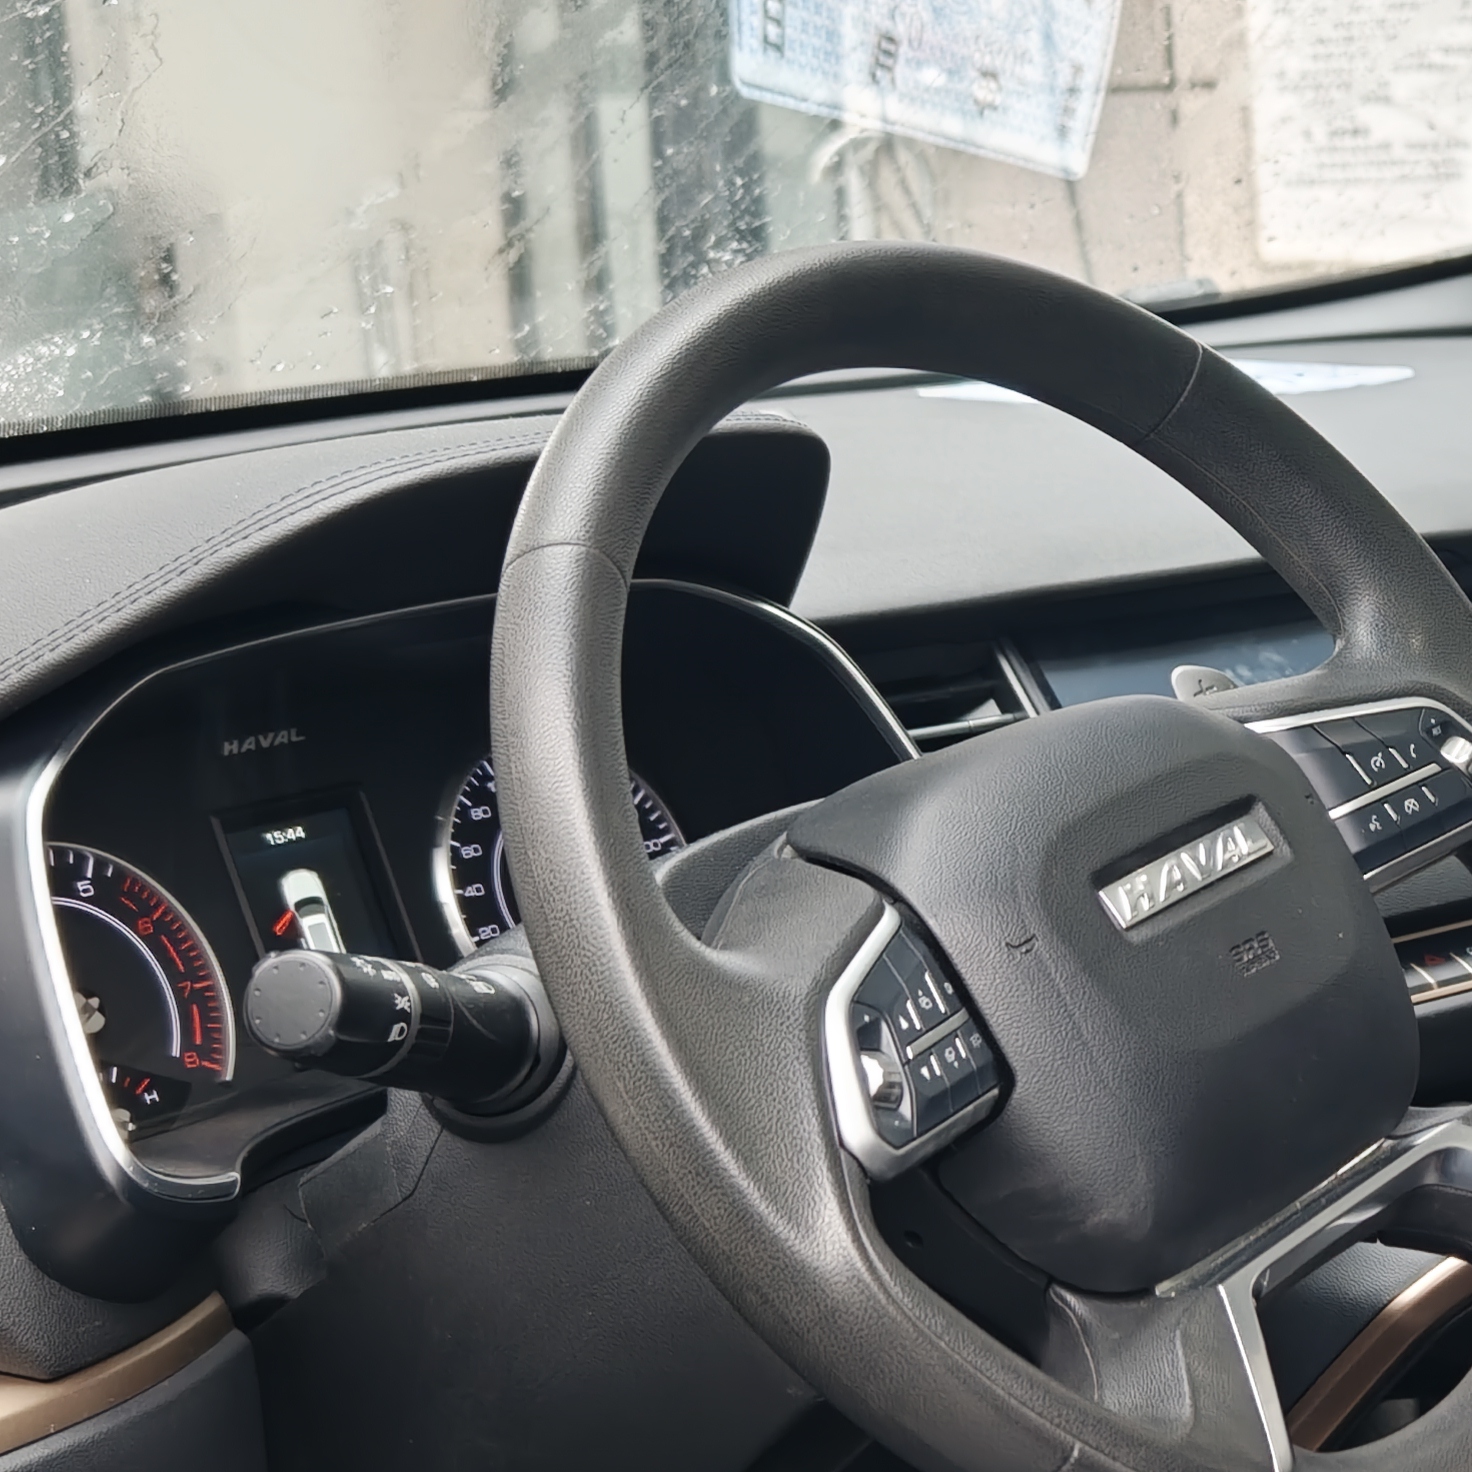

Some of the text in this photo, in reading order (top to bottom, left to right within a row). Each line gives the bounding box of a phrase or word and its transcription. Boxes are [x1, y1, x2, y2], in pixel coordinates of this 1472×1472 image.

[223, 728, 306, 756] HAVAL
[470, 806, 491, 821] 80
[262, 826, 306, 846] 15:44
[460, 844, 483, 859] 60
[1117, 823, 1270, 921] HAVAL
[76, 880, 95, 898] 5
[463, 883, 486, 897] 40
[477, 925, 500, 941] 20
[178, 981, 192, 998] 7
[184, 1051, 199, 1069] 8
[143, 1090, 160, 1106] H
